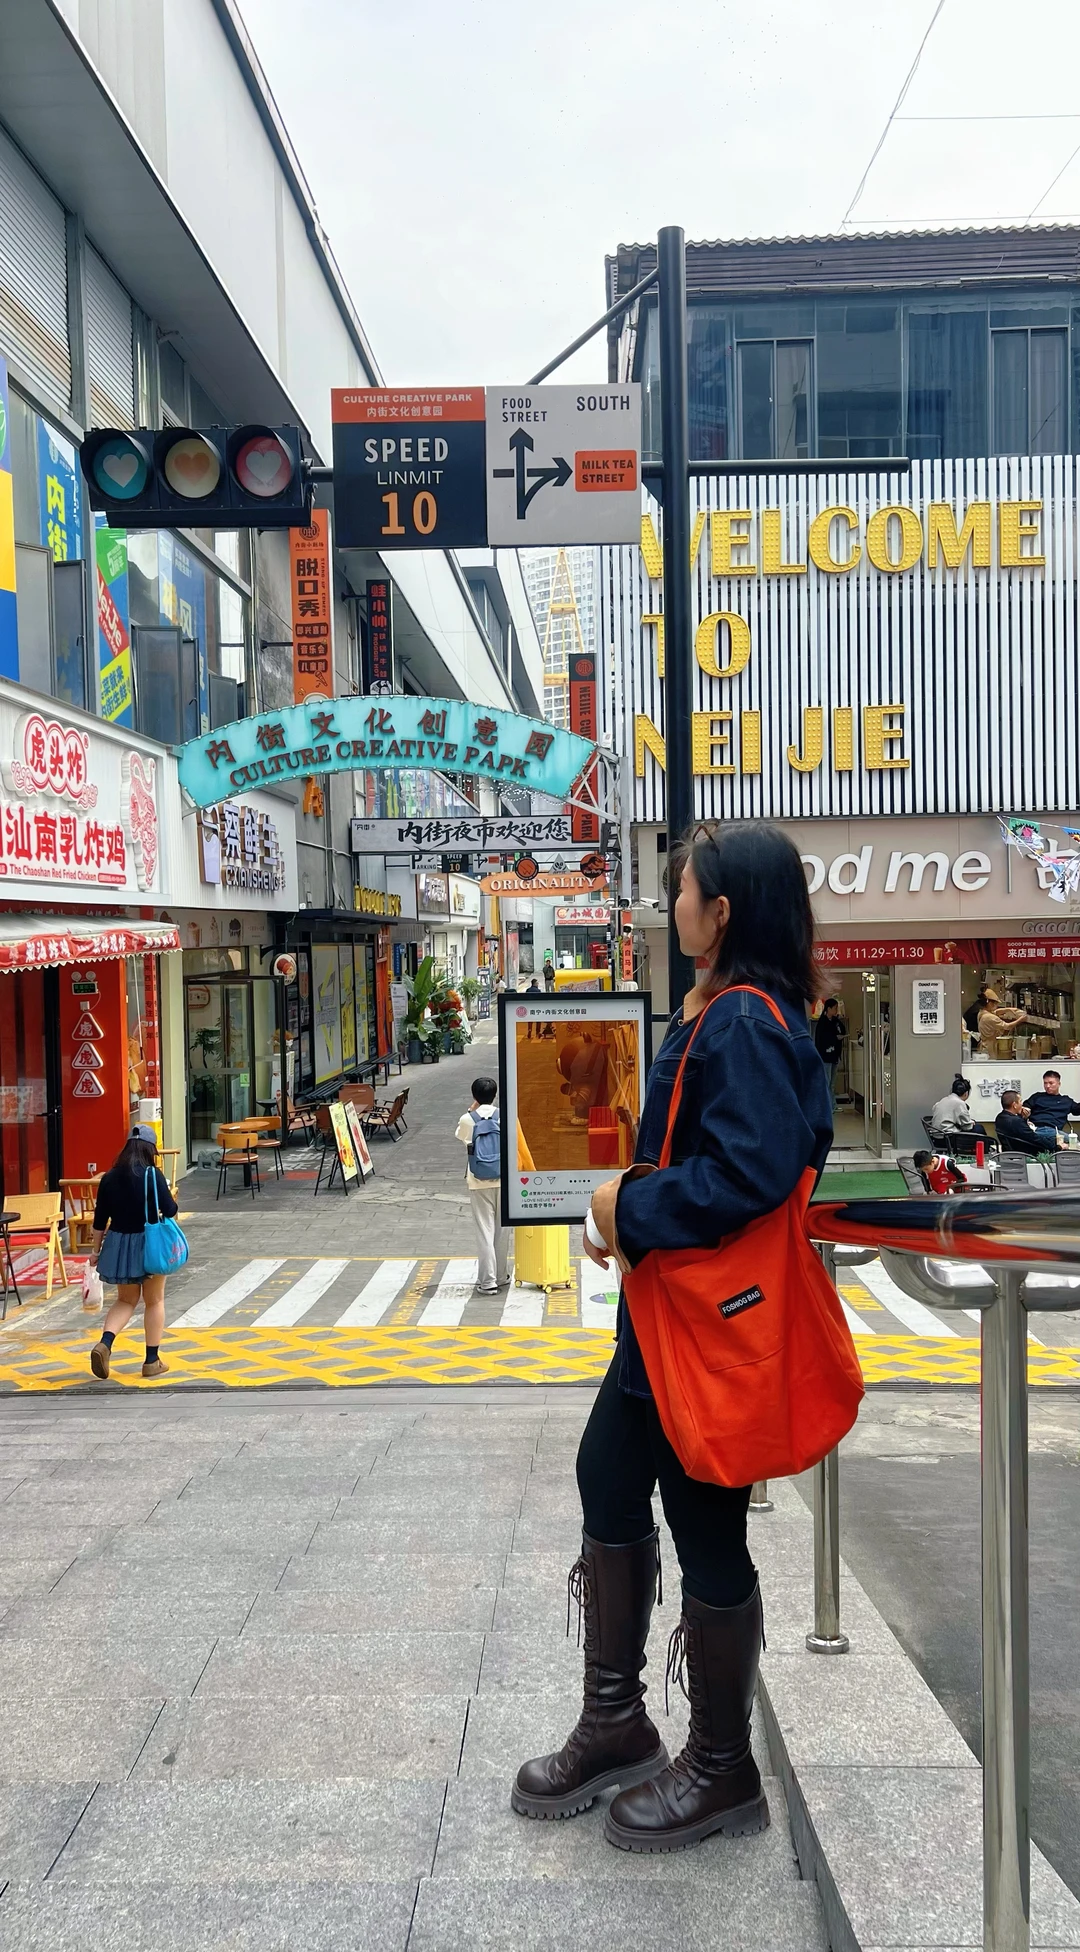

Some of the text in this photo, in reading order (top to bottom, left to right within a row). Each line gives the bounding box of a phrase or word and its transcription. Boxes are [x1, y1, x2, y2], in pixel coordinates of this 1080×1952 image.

[343, 393, 473, 404] CULTURE CREATIVE PARK
[502, 398, 532, 409] FOOD
[576, 396, 630, 412] SOUTH
[366, 405, 443, 418] 内街文化创意园
[502, 411, 548, 423] STREET
[364, 437, 449, 463] SPEED
[582, 459, 634, 470] MILK TEA
[376, 470, 444, 486] LINMIT
[582, 473, 624, 484] STREET
[380, 491, 438, 535] 10
[296, 558, 320, 618] 脱口秀
[300, 645, 325, 655] 音乐会
[579, 686, 591, 716] NEIJIE
[205, 708, 555, 769] 内街文化创意园
[634, 703, 910, 778] NEI JIE
[30, 727, 83, 784] 虎头炸
[229, 740, 531, 789] CULTURE CREATIVE PARK
[398, 820, 572, 848] 内街夜市欢迎您
[581, 813, 592, 840] PARK
[0, 806, 125, 871] 汕南乳炸鸡
[9, 863, 21, 874] The
[23, 865, 51, 878] Chaoshan
[52, 869, 61, 878] Red
[63, 870, 76, 880] Fried
[78, 872, 97, 881] Chicken
[449, 863, 461, 872] 10
[884, 846, 993, 893] me
[490, 876, 596, 891] ORIGINALITY
[1022, 920, 1070, 935] Good
[853, 947, 924, 960] 11.29-11.30
[1007, 948, 1046, 958] 来店里喝
[920, 1012, 938, 1021] 扫码
[79, 1021, 94, 1037] 虎
[79, 1049, 93, 1065] 虎
[80, 1078, 94, 1093] 虎
[747, 1290, 761, 1302] BAG
